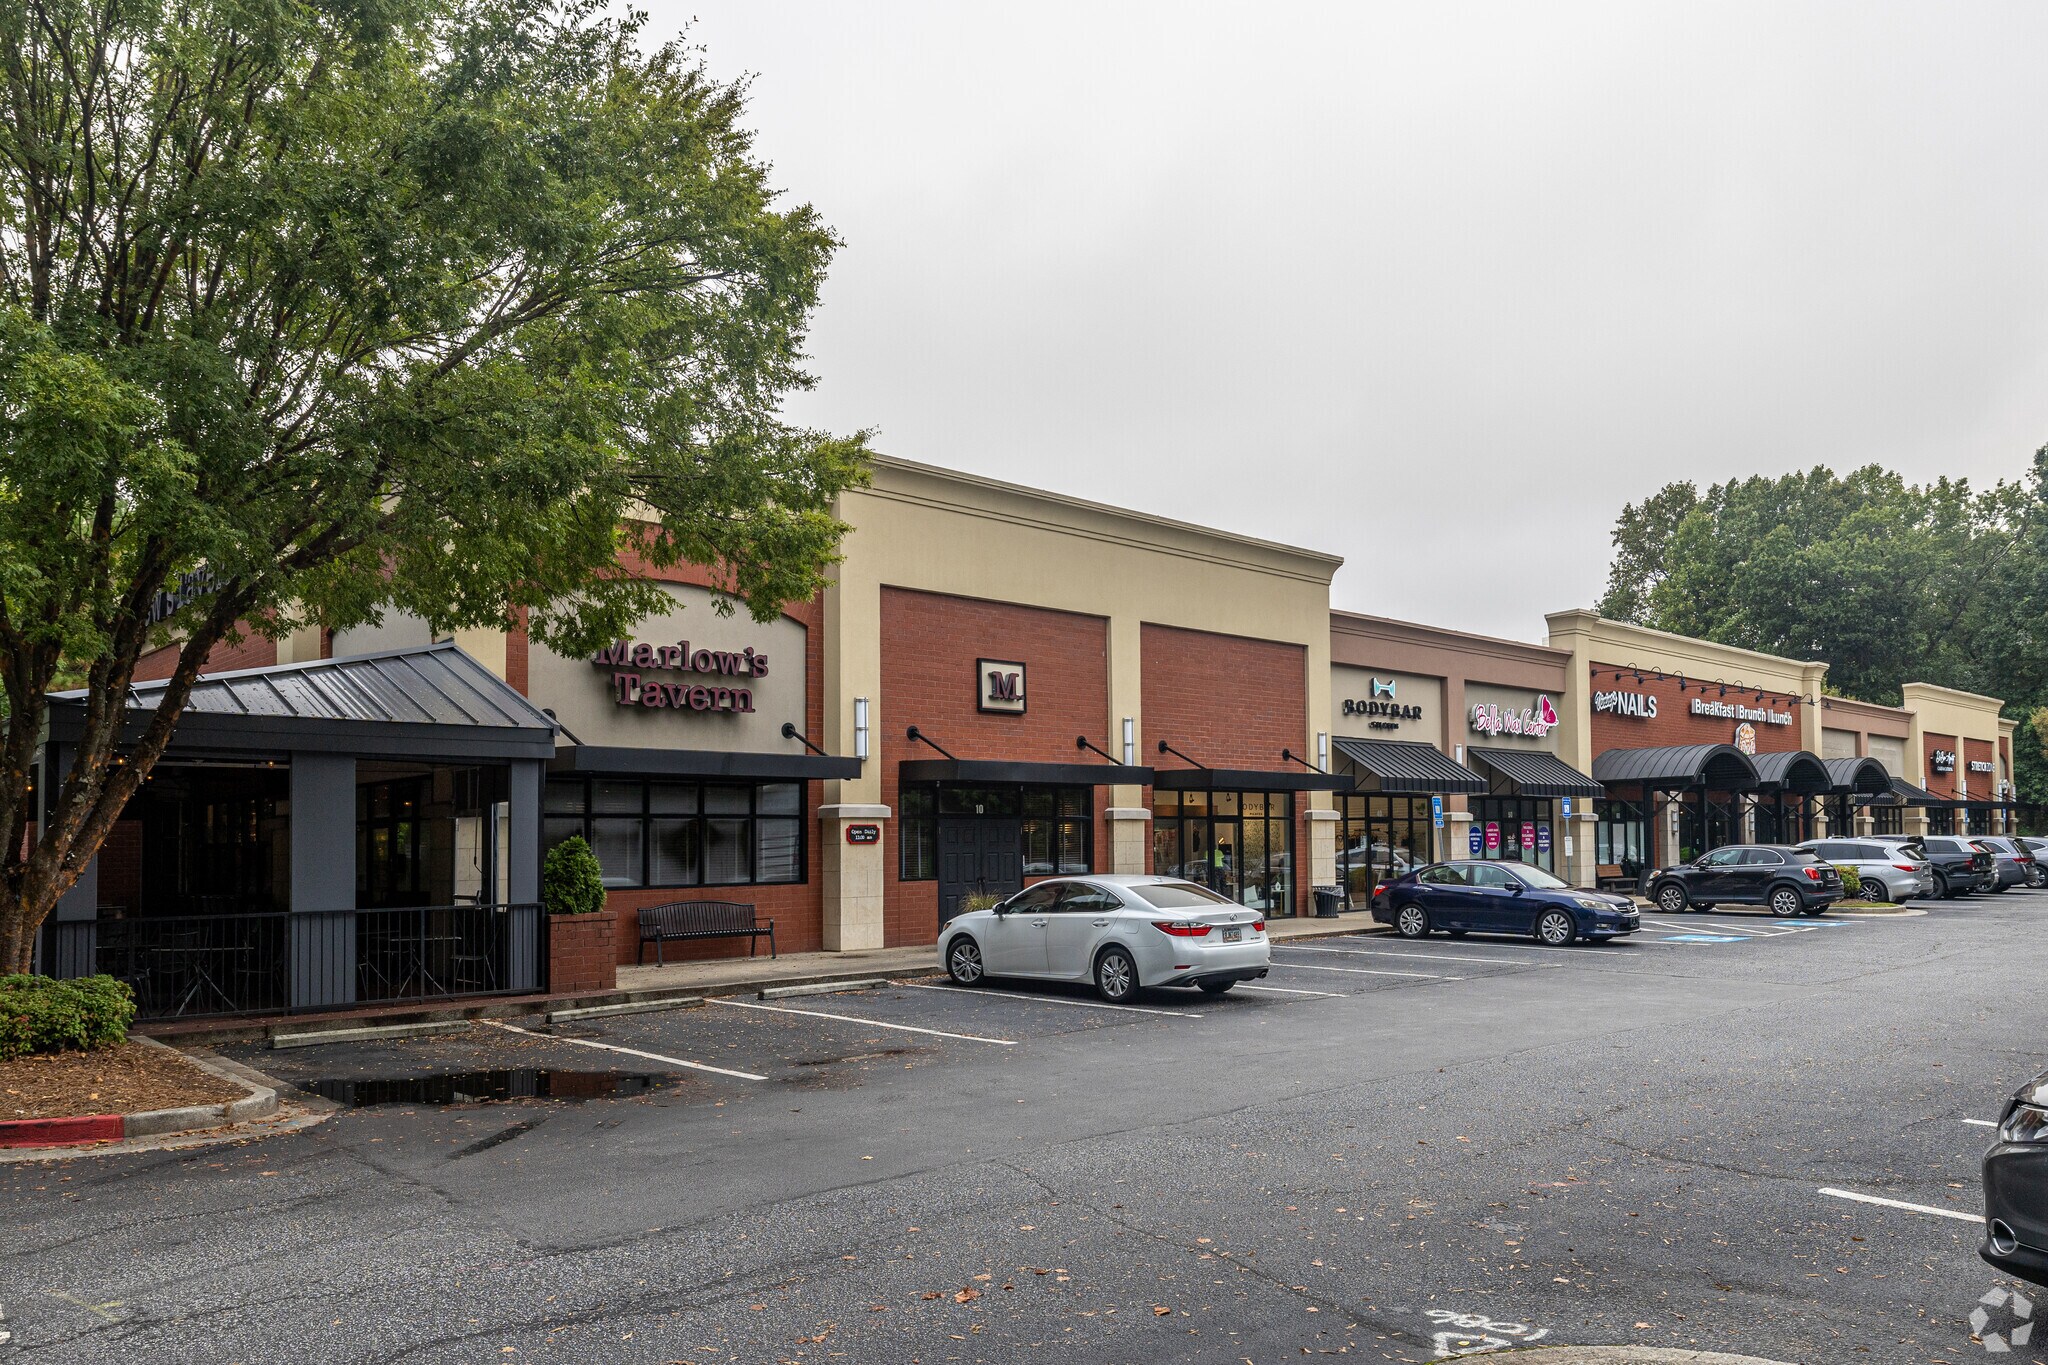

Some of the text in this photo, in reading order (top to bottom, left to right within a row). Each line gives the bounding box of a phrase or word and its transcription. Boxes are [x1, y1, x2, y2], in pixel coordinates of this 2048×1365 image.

[593, 640, 769, 678] Marlow's
[612, 671, 756, 713] Tavern
[1618, 691, 1657, 718] NAILS
[1343, 699, 1422, 720] BODYBAR
[1474, 704, 1549, 737] Bella Wax Center
[1692, 698, 1793, 725] Breakfast Brunch Lunch
[975, 804, 984, 814] 10
